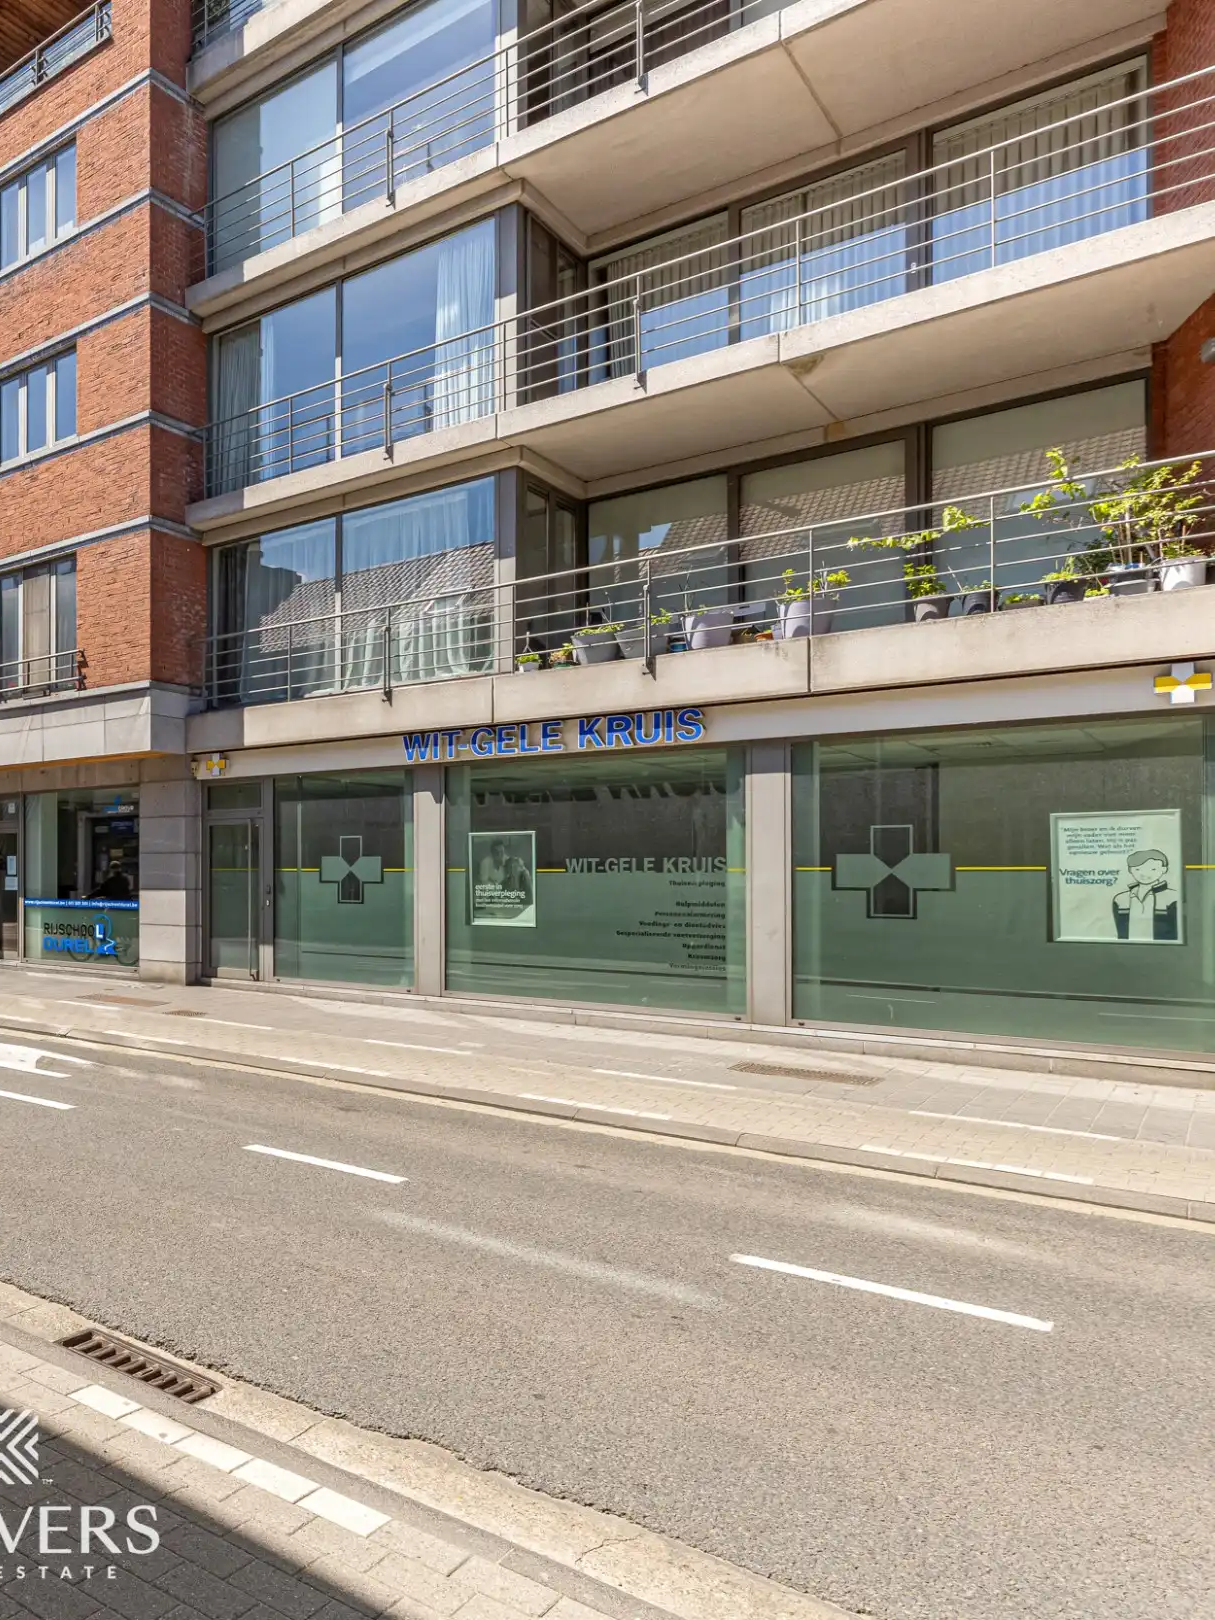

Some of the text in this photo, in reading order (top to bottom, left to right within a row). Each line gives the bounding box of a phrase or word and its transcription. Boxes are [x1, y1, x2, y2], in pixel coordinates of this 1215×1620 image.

[402, 708, 705, 762] WIT-GELE KRUIS
[565, 856, 727, 874] WIT-GELE KRUIS
[1059, 868, 1095, 877] Vragen
[1065, 876, 1118, 887] thuiszorg?
[43, 922, 105, 939] RIJSCHOOL
[43, 936, 95, 954] DUREL
